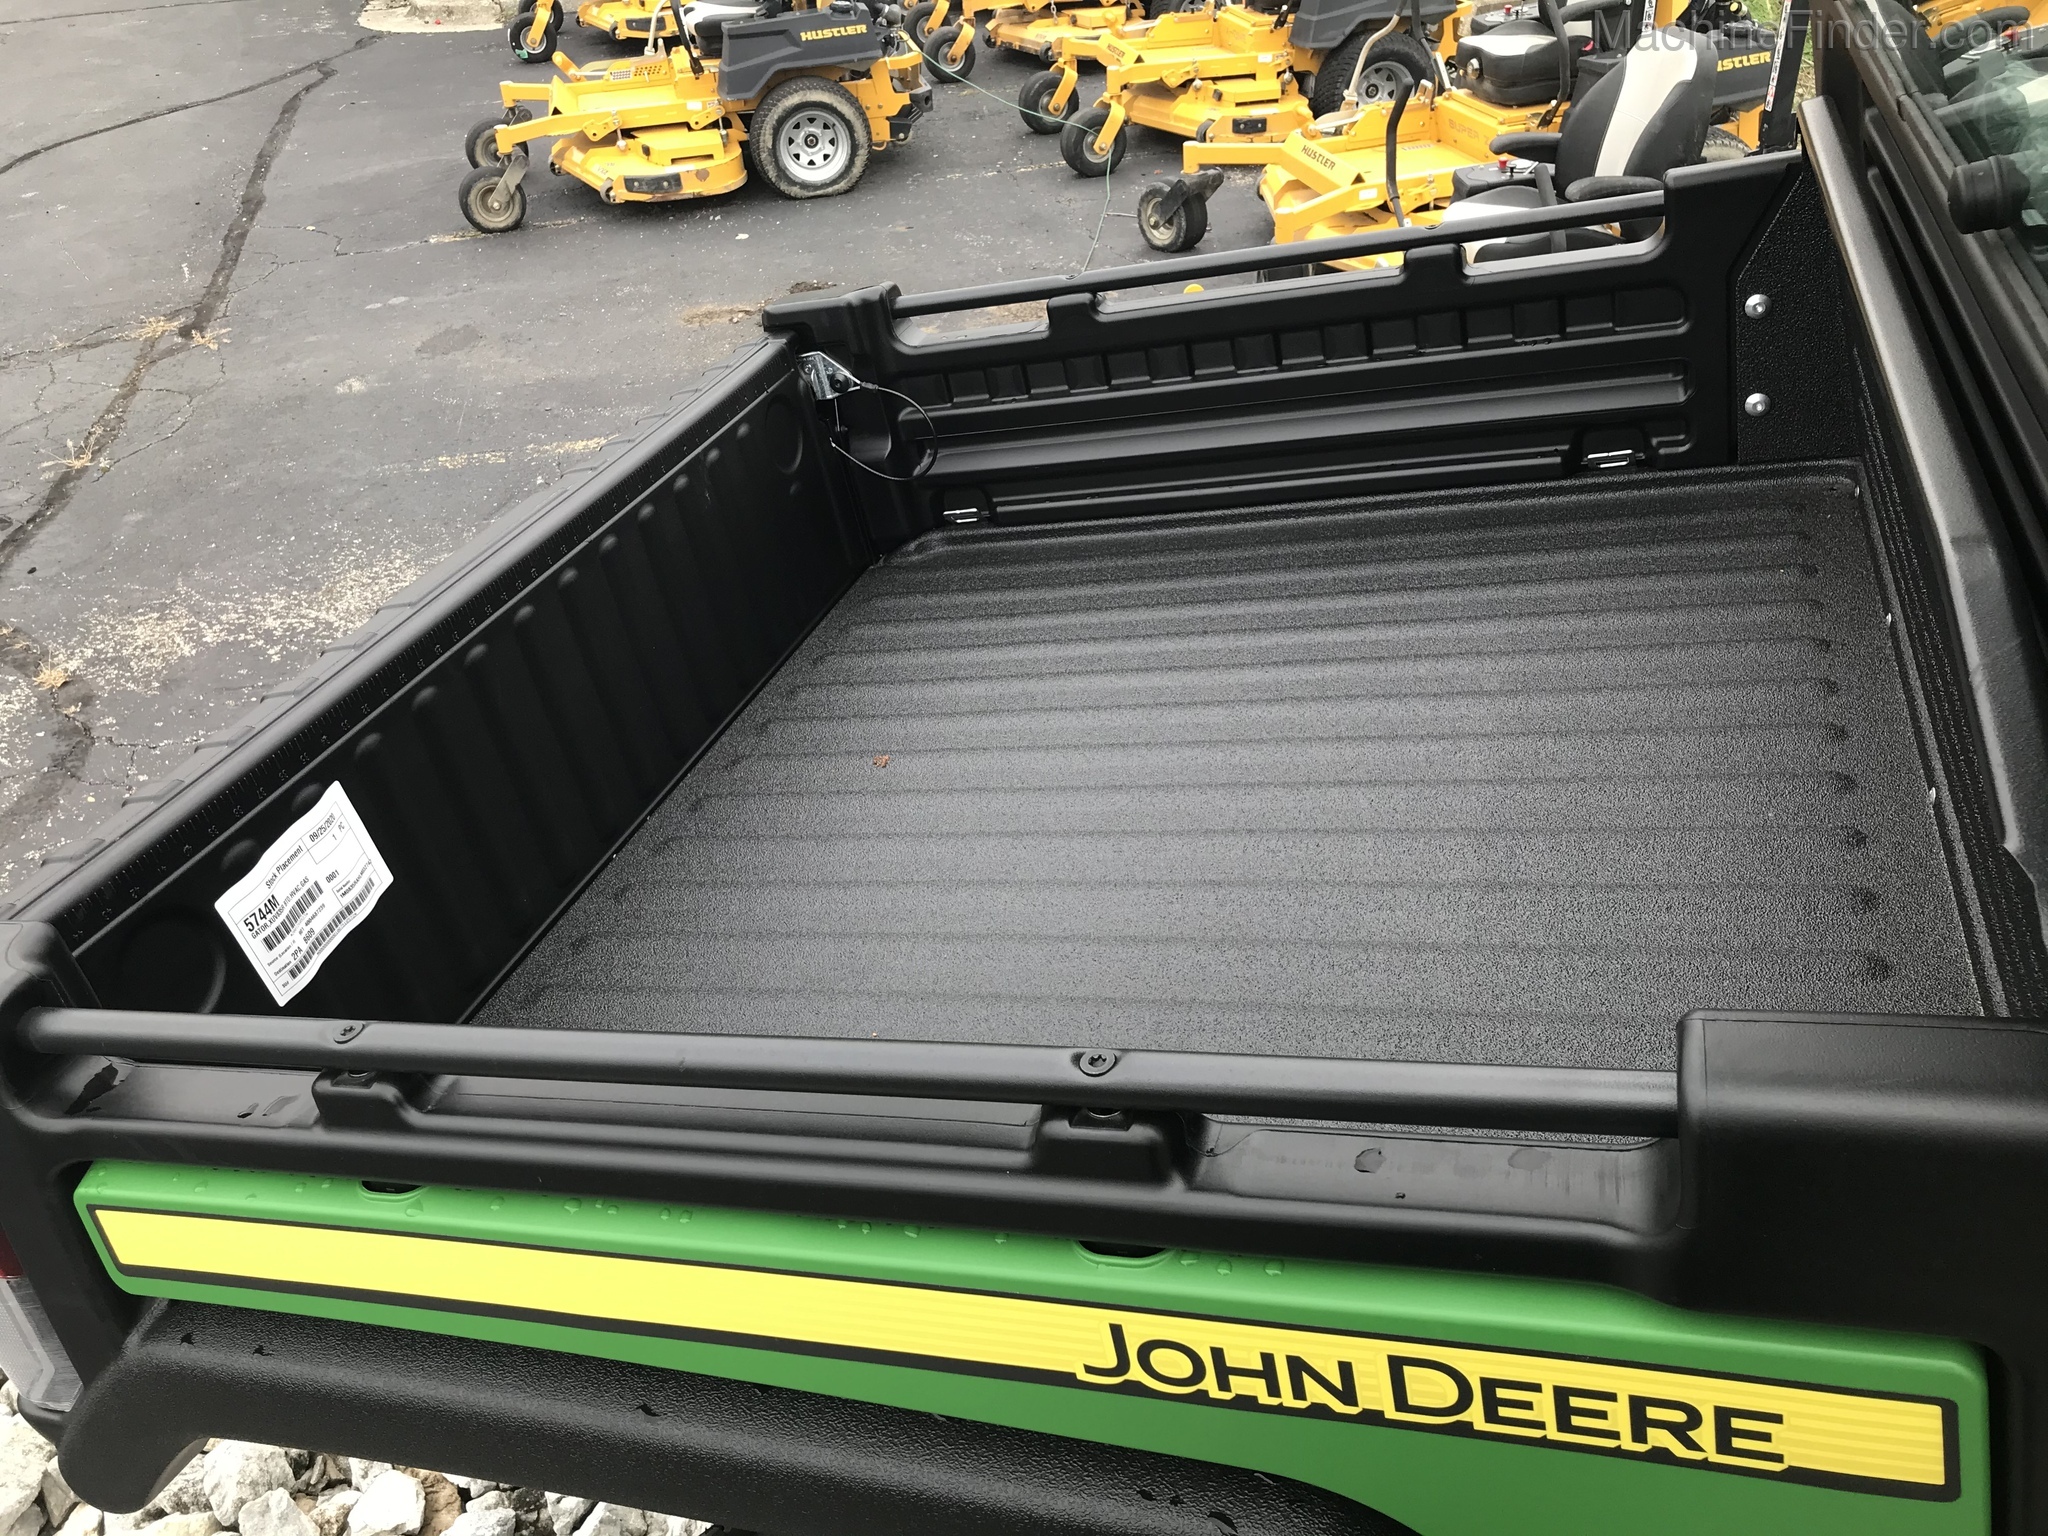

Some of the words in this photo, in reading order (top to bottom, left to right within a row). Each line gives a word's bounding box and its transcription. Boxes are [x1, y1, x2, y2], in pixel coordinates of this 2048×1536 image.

[800, 24, 868, 41] HUSTLER
[1301, 145, 1336, 171] HUSTLER
[265, 868, 278, 889] Stock
[275, 845, 304, 875] Placement
[243, 894, 280, 932] 5744M
[1083, 1322, 1355, 1410] JOHN
[1386, 1353, 1786, 1466] DEERE
